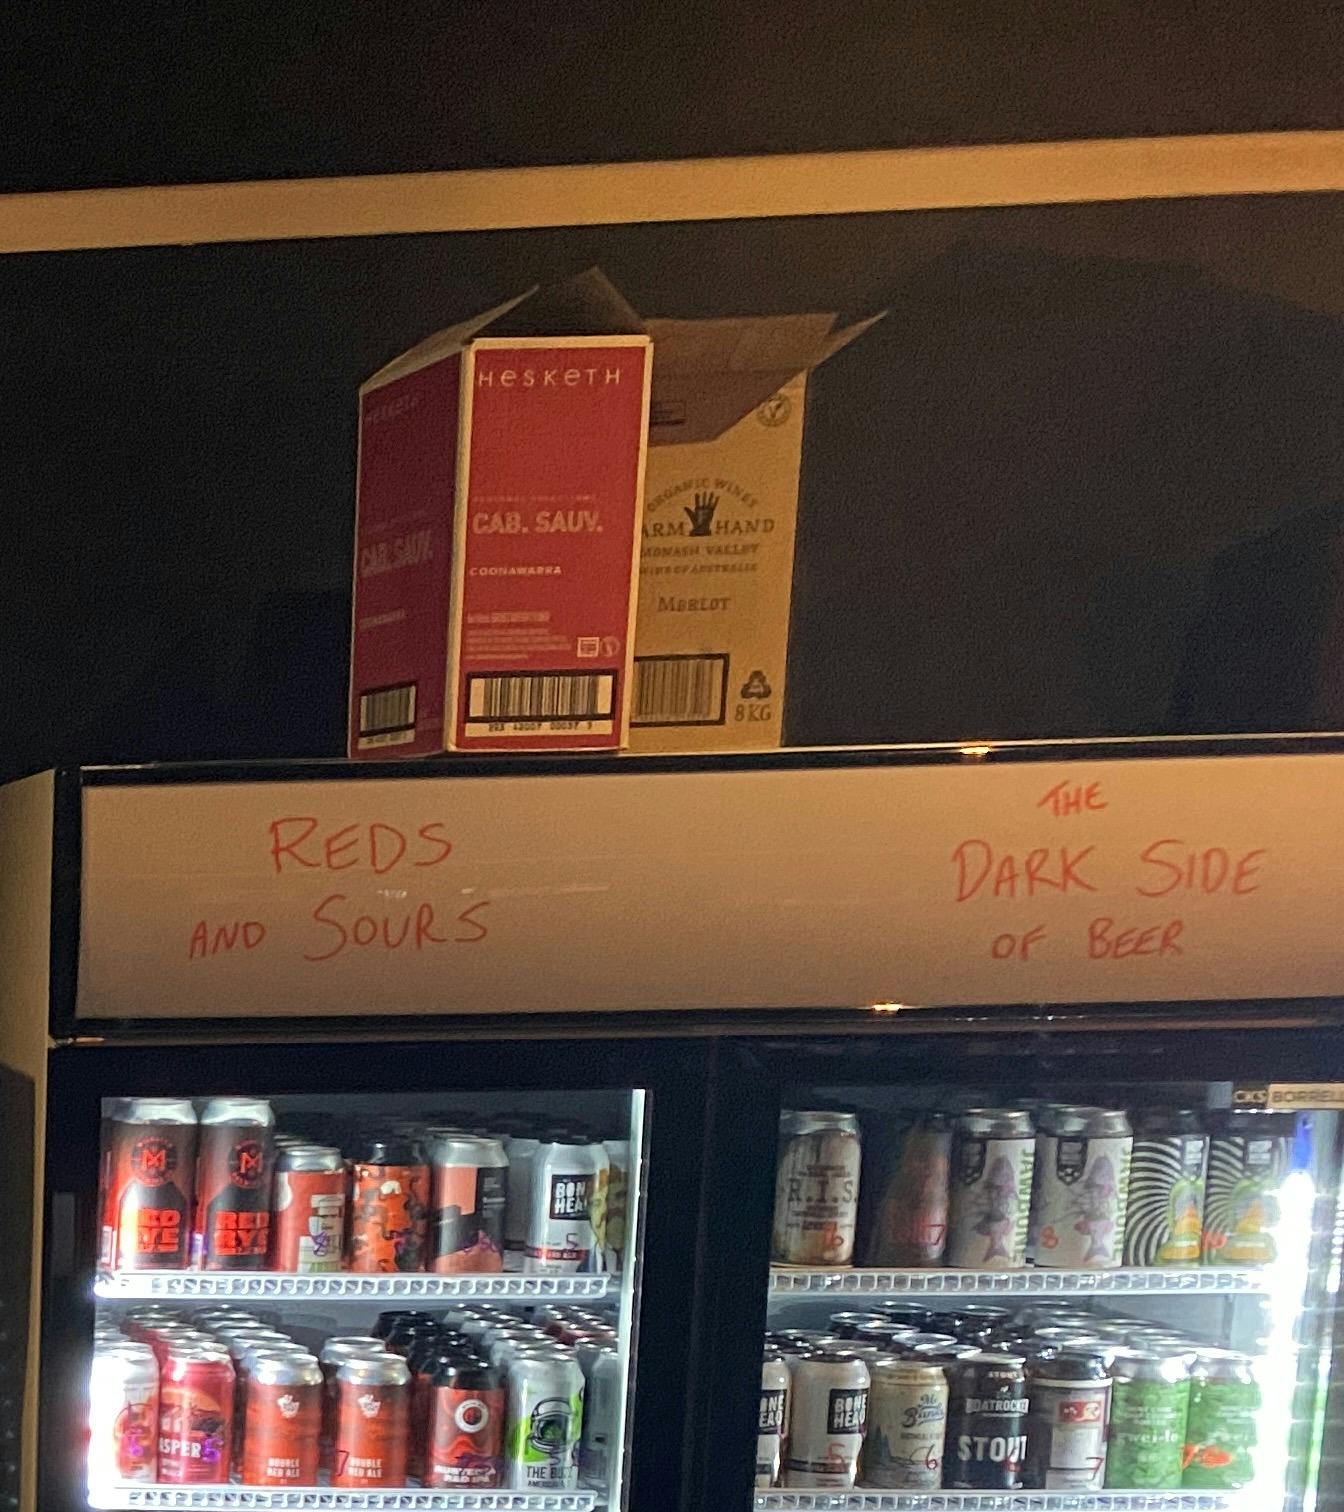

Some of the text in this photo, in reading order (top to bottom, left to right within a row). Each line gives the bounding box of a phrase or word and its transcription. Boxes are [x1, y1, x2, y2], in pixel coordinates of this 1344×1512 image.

[471, 510, 603, 535] CAB. SAUV.
[641, 518, 775, 538] ARM HAND
[657, 596, 732, 613] MERLOT
[734, 704, 772, 722] 8 KG
[1039, 781, 1108, 817] THE
[269, 817, 453, 872] REDS
[953, 843, 1266, 902] DARK SIDE
[189, 901, 489, 963] AND SOURS
[992, 916, 1184, 961] OF BEER
[555, 1181, 587, 1198] BON
[554, 1196, 588, 1214] HEA
[833, 1397, 866, 1414] BONE
[957, 1435, 1028, 1463] STOUT
[526, 1465, 545, 1479] THE
[1084, 1456, 1104, 1482] 7
